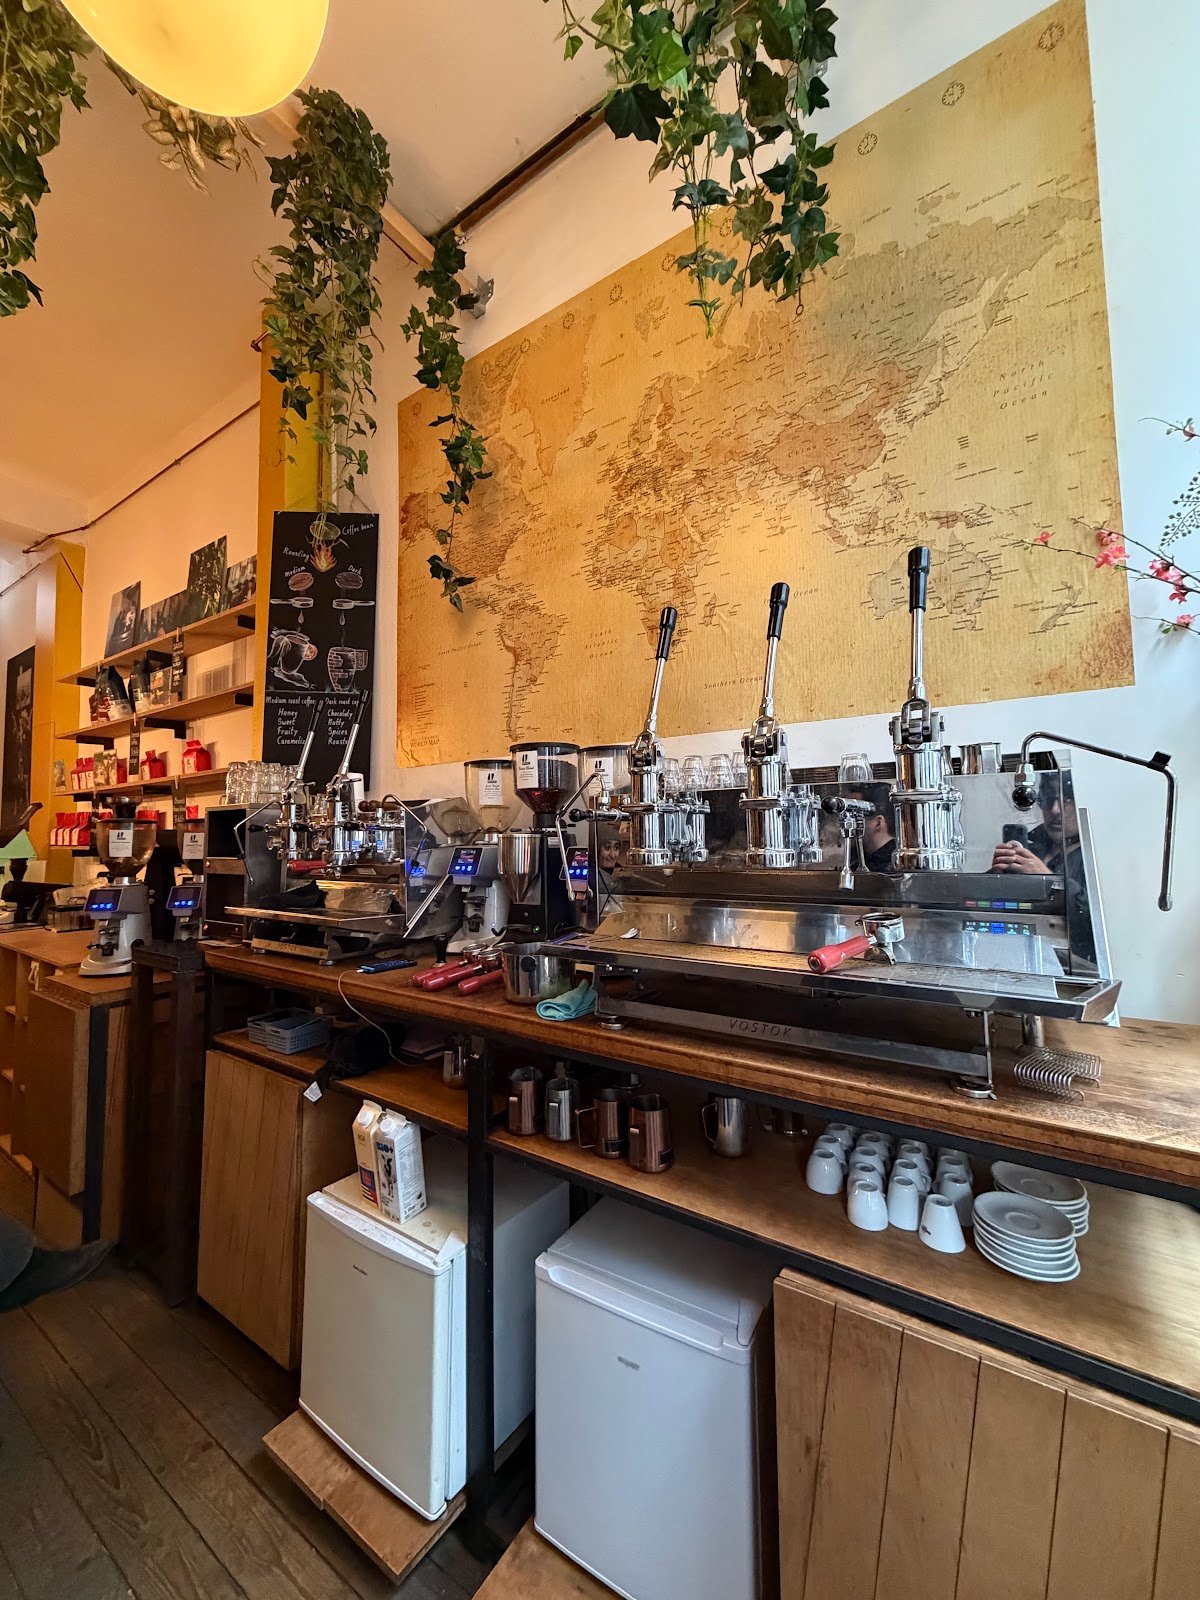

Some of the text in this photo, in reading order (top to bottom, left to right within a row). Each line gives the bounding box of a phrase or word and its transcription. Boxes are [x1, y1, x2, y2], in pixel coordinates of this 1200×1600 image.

[999, 360, 1044, 381] North
[993, 372, 1054, 398] Pacific
[1000, 390, 1047, 410] Ocean
[342, 524, 360, 536] Coffee
[283, 547, 310, 563] Roasting
[347, 564, 363, 576] Dark
[793, 587, 819, 599] Ocean
[704, 676, 764, 690] Southern Ocean
[266, 696, 316, 708] Medium roast coffee
[325, 697, 338, 706] Dark
[338, 697, 351, 705] roast
[278, 708, 299, 720] Honey
[327, 708, 353, 720] Chocolaty
[277, 718, 296, 727] Sweet
[277, 727, 299, 737] Fruity
[327, 727, 349, 738] Spices
[729, 1019, 792, 1038] VOSTOK
